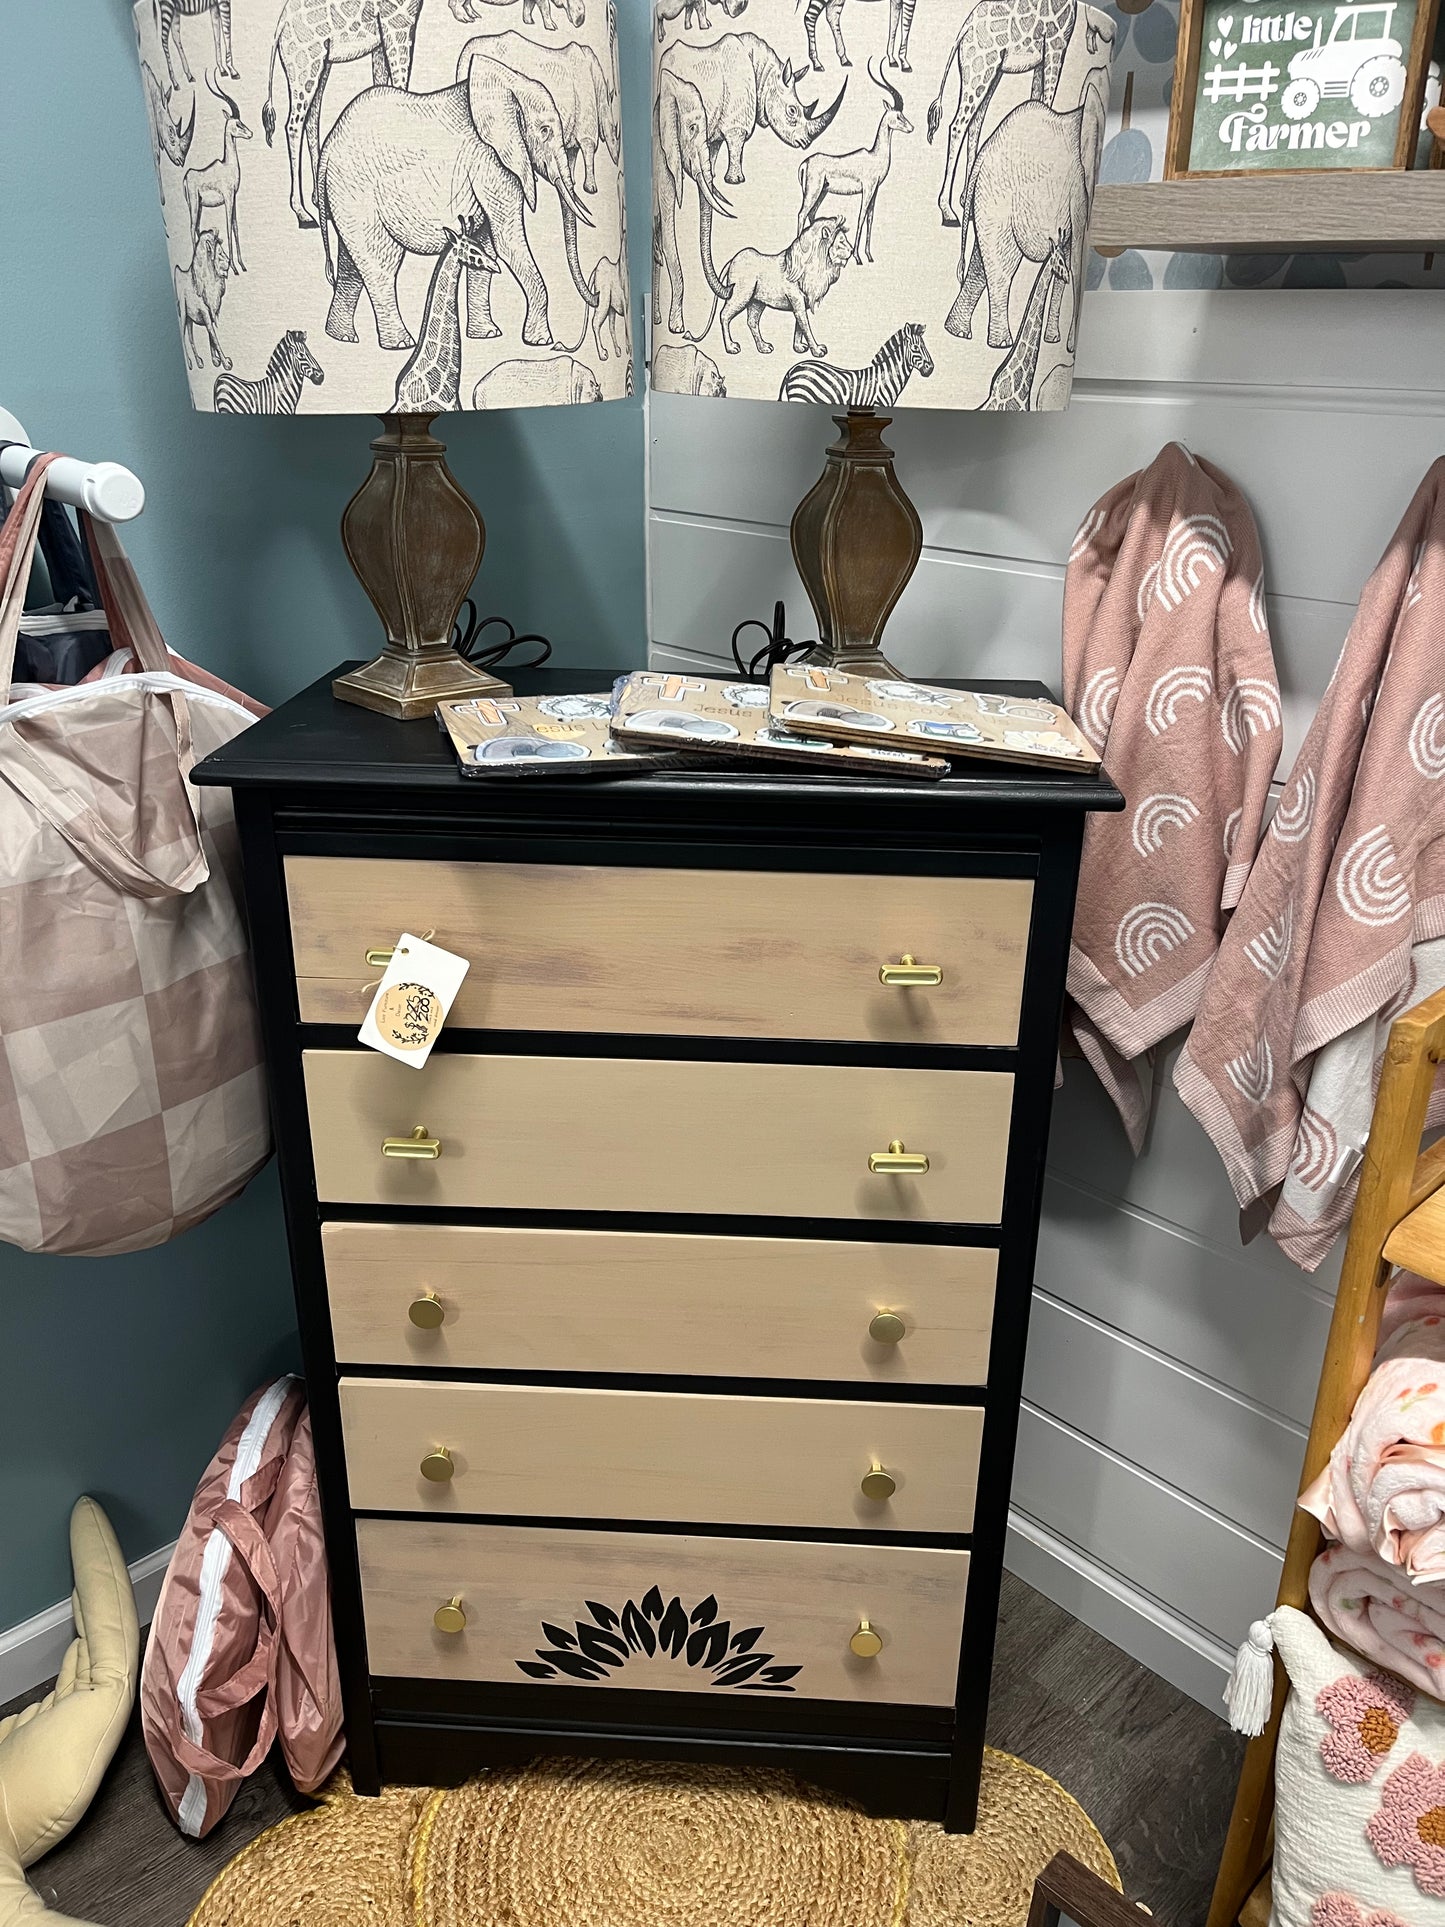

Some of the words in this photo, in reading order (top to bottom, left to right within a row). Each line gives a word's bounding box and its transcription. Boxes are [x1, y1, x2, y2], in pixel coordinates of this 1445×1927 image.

[1241, 11, 1313, 44] little
[1218, 103, 1371, 152] Farmer
[693, 703, 753, 718] Jesus
